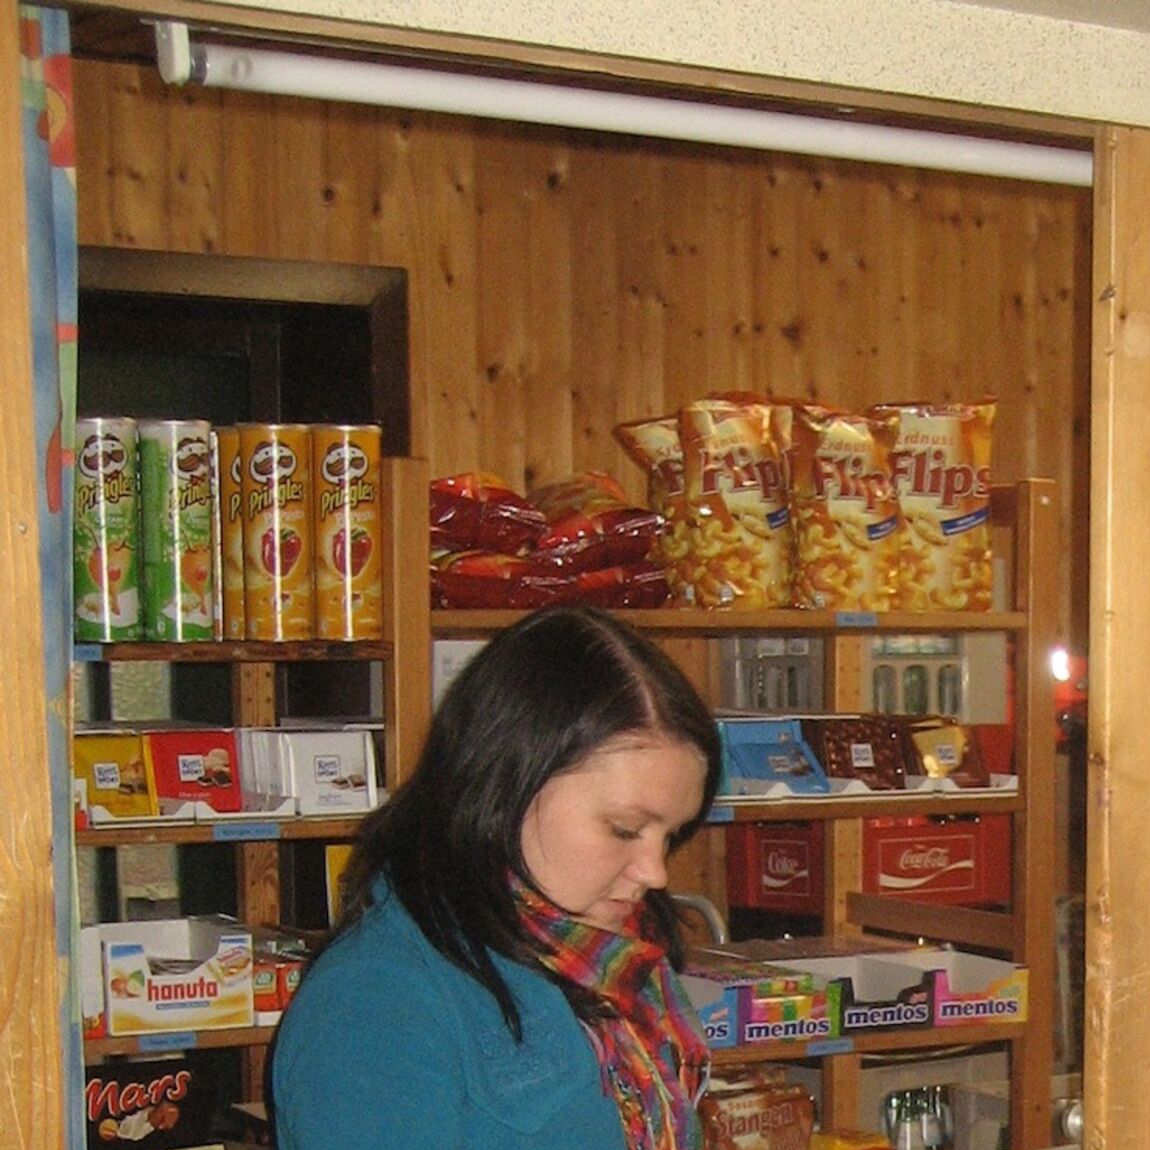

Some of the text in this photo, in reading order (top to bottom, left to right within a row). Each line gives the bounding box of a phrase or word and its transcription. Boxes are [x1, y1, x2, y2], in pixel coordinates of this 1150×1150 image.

[888, 449, 991, 509] Flips
[148, 979, 218, 1001] hanuta
[847, 1004, 927, 1025] mentos
[941, 998, 1018, 1017] mentos
[747, 1017, 829, 1039] mentos
[86, 1071, 191, 1121] Mars
[716, 1103, 793, 1137] Stangen
